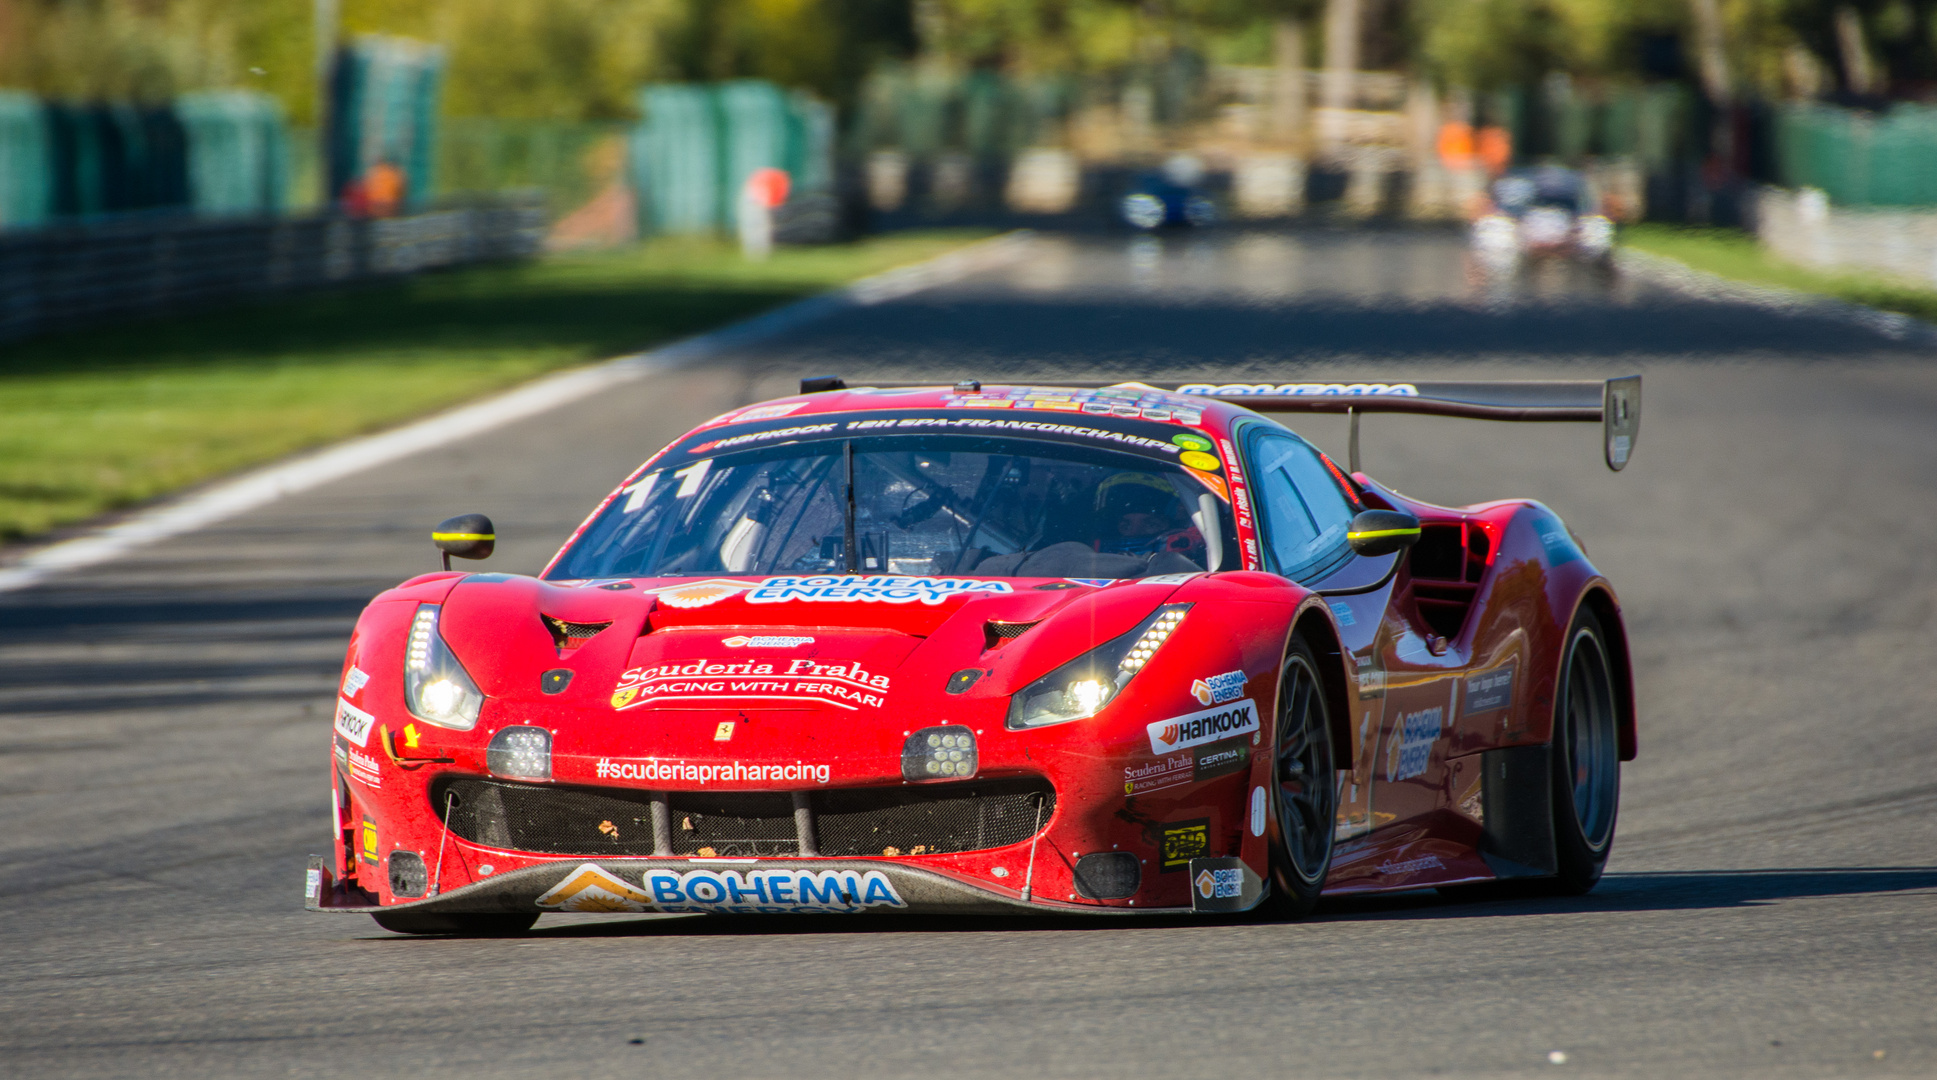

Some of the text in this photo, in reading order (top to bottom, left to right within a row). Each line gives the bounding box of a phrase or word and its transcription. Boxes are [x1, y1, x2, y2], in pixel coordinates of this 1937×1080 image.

[846, 419, 897, 430] 12H
[896, 419, 1181, 453] SPA-FRANCORCHAMPS
[622, 459, 714, 514] 11
[753, 588, 948, 601] ENERGY
[766, 577, 1008, 592] BOHEMIA
[617, 659, 890, 689] Scuderia Praha
[1208, 670, 1247, 690] BOHEMIA
[641, 681, 885, 708] RACING WITH FERRARI
[1213, 686, 1244, 701] ENERGY
[1124, 754, 1193, 779] Scuderia Praha
[1199, 750, 1239, 766] CERTINA
[596, 758, 829, 784] #scuderiapraharacing
[651, 876, 901, 905] BOHEMIA
